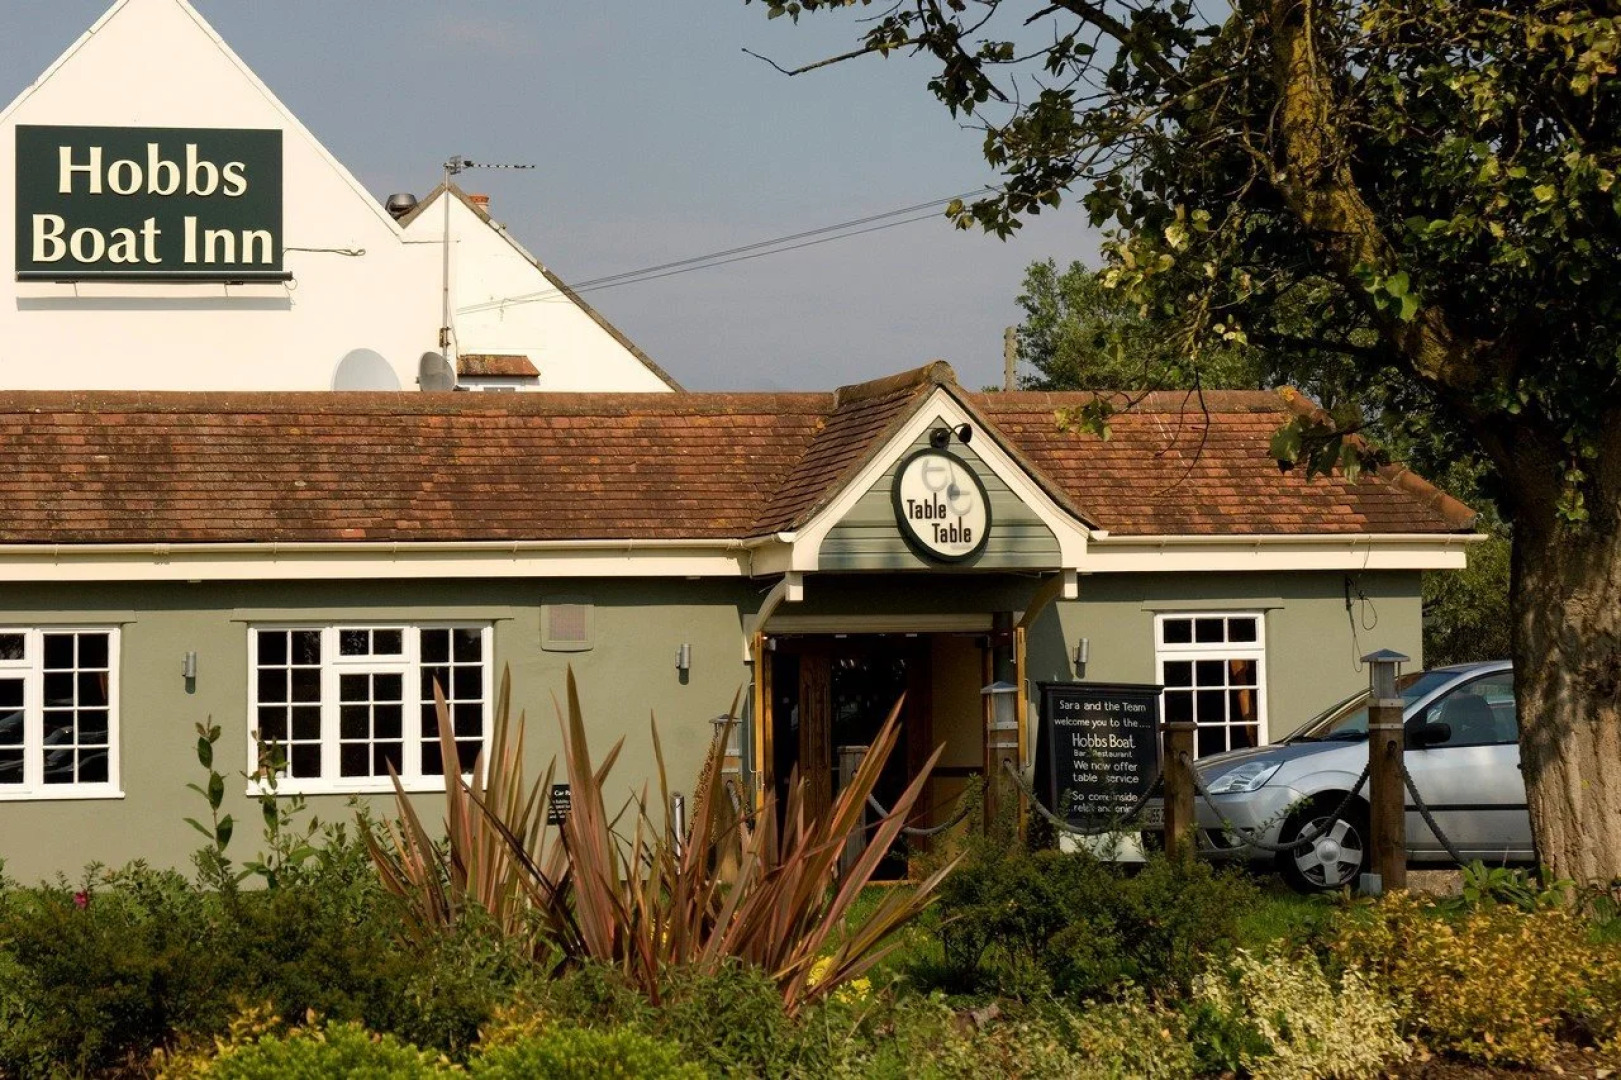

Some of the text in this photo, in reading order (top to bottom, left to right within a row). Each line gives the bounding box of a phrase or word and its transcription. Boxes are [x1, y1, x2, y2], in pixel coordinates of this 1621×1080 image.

[58, 142, 248, 197] Hobbs
[32, 213, 273, 265] Boat Inn
[906, 492, 947, 520] Table
[931, 516, 972, 543] Table
[1059, 699, 1147, 712] Sara and the Team
[1054, 716, 1090, 727] welcome
[1091, 719, 1108, 730] you
[1109, 717, 1120, 728] to
[1072, 732, 1137, 749] Hobbs Boat
[1073, 760, 1138, 772] We now offer
[1072, 772, 1140, 784] table service
[1072, 790, 1085, 801] So
